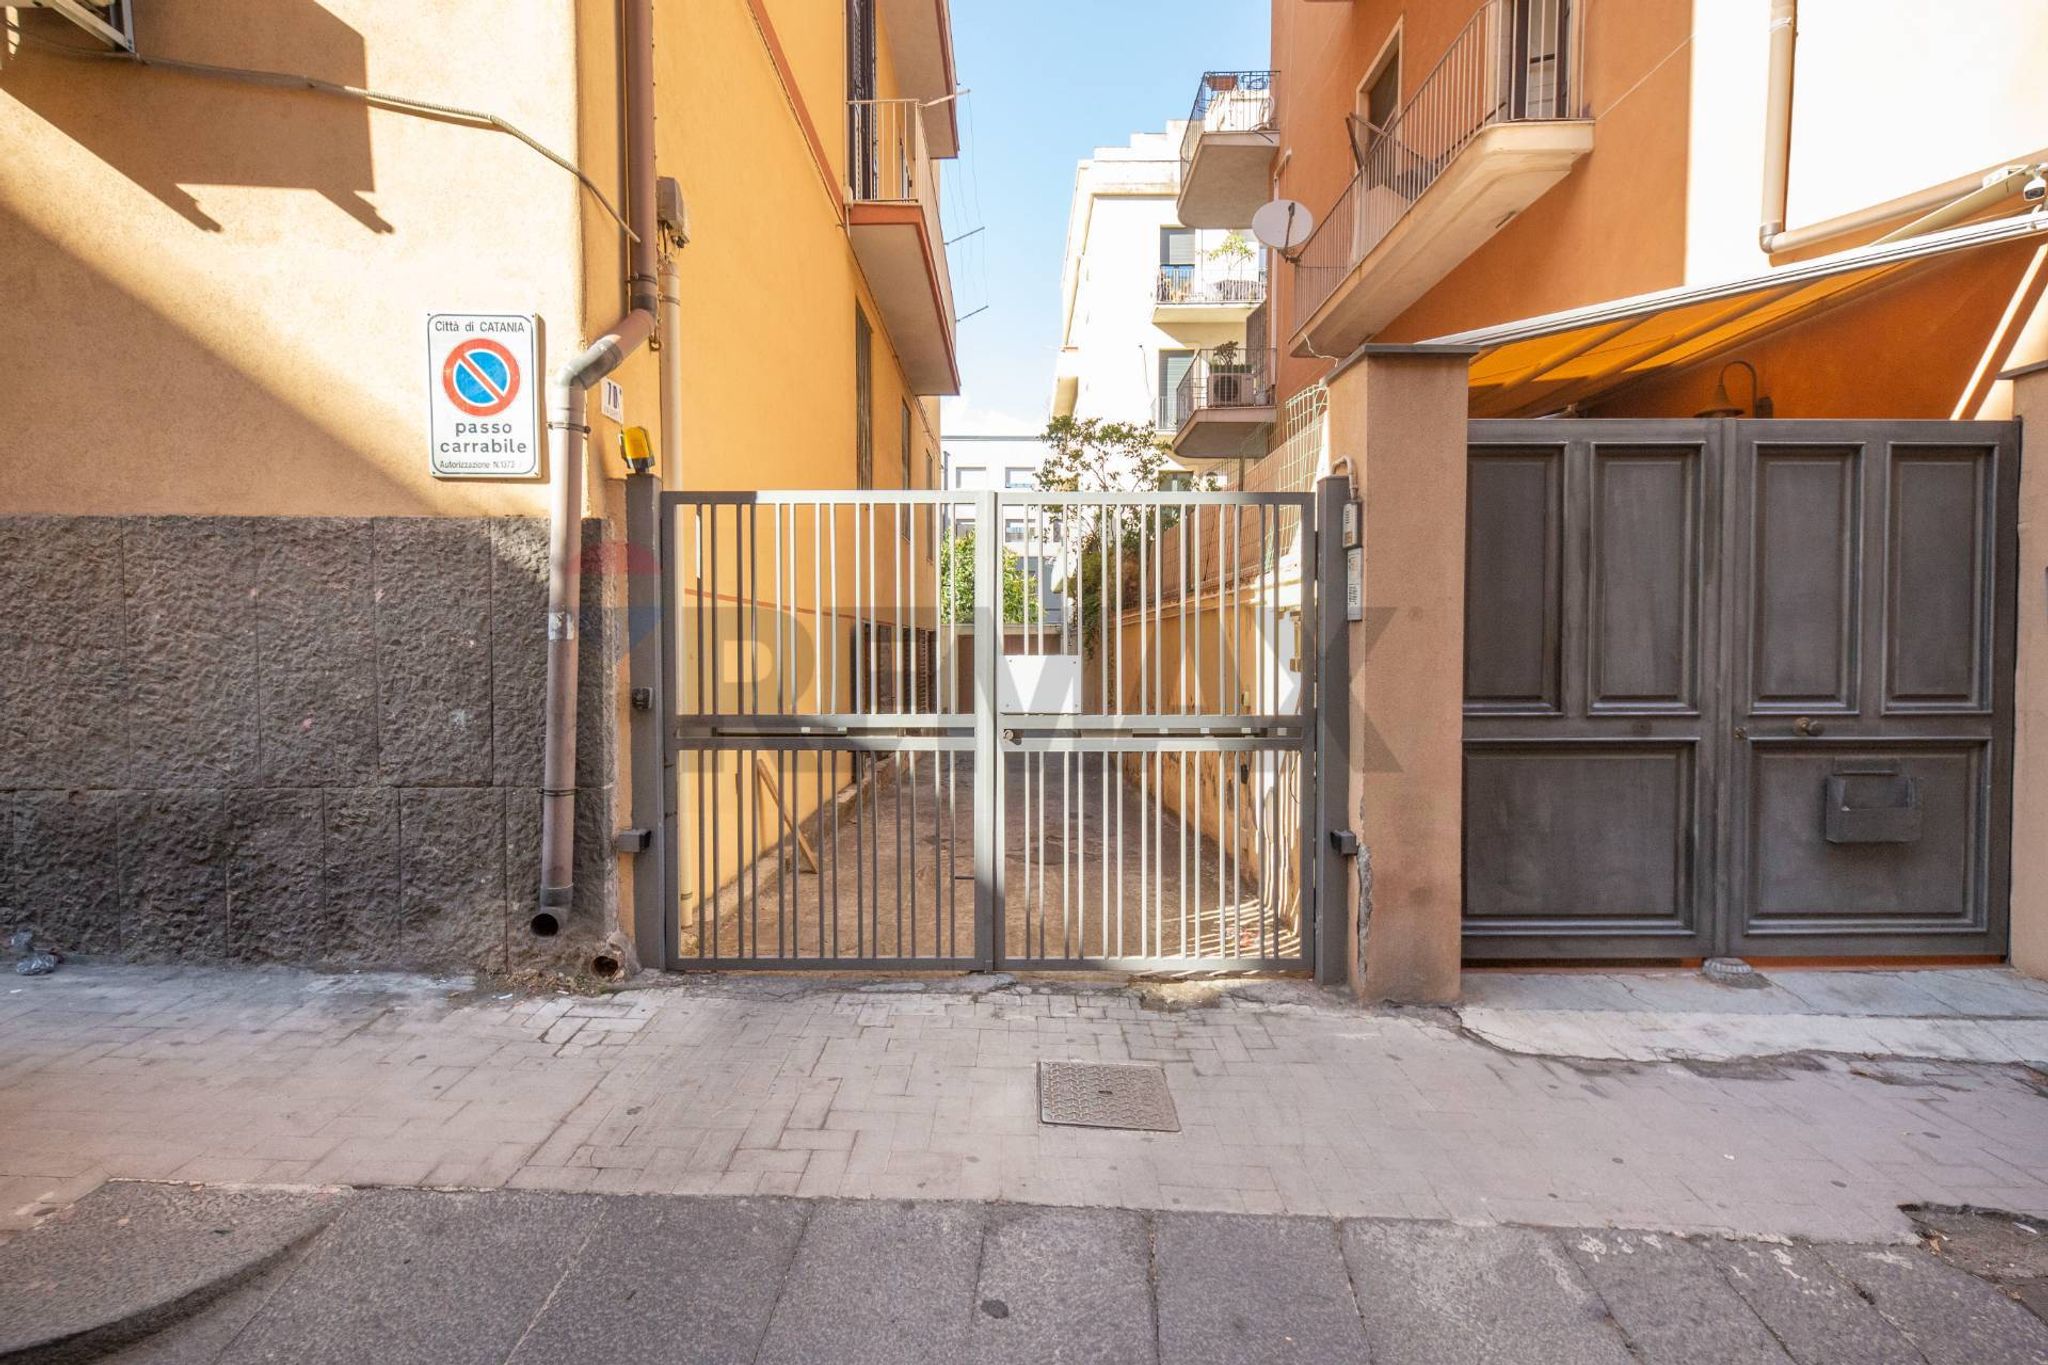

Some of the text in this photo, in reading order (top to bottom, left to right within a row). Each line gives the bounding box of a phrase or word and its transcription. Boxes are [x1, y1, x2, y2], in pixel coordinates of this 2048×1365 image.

[435, 321, 525, 333] Città di CATANIA
[455, 422, 512, 437] passo
[440, 438, 527, 453] carrabile
[440, 460, 490, 469] Autorizzazione
